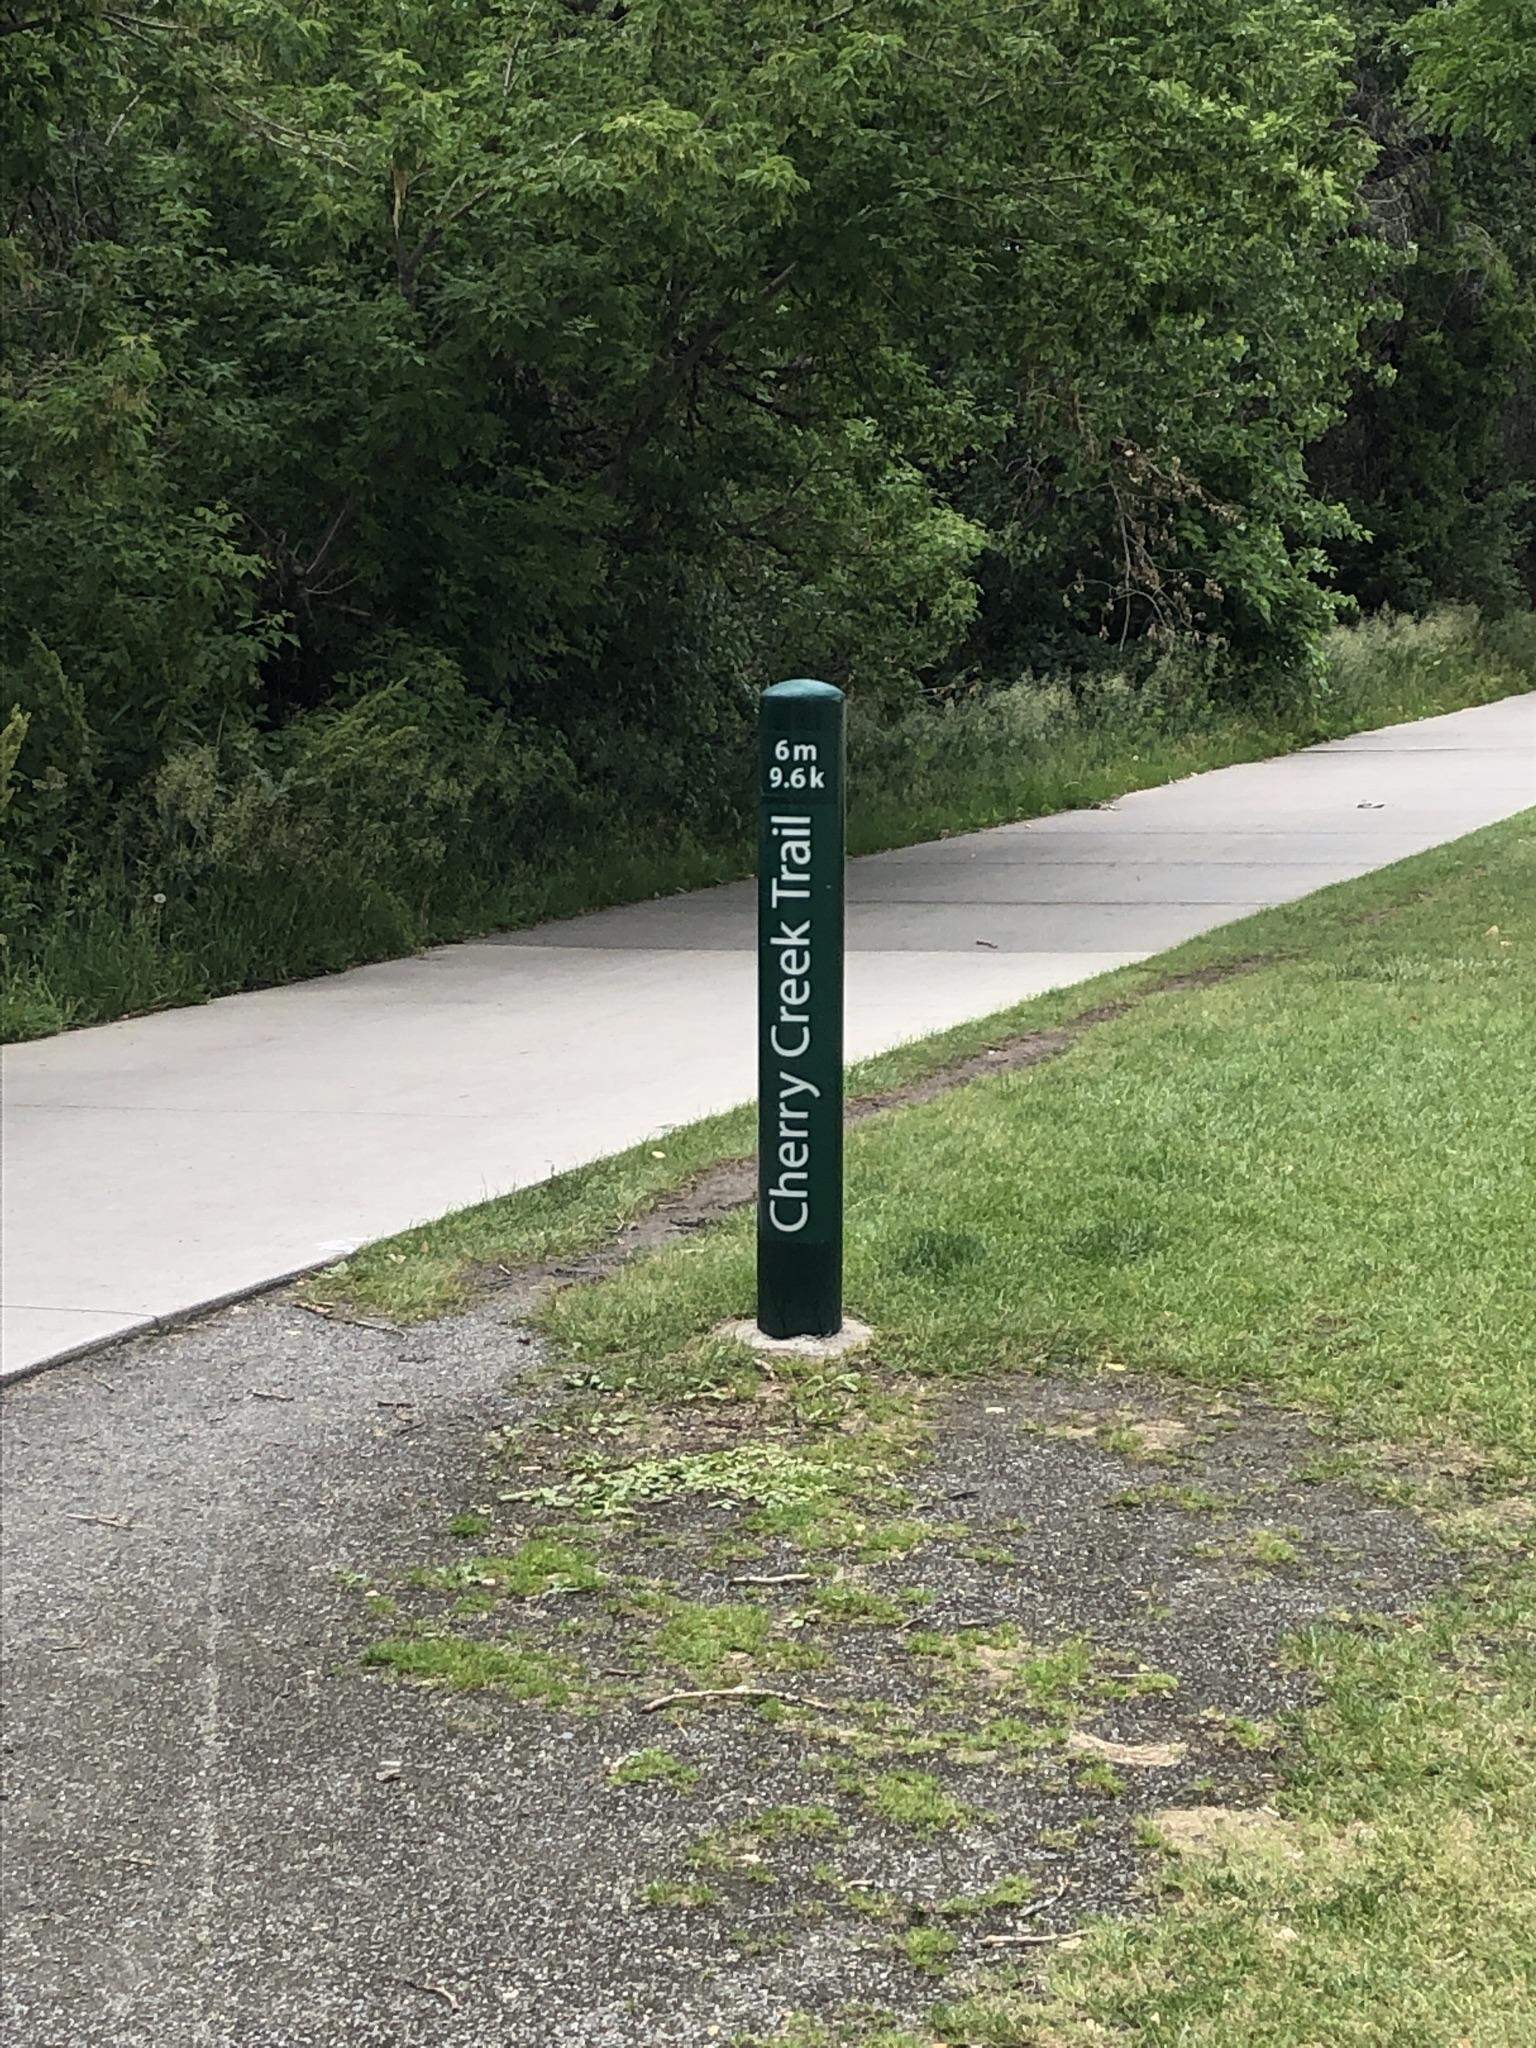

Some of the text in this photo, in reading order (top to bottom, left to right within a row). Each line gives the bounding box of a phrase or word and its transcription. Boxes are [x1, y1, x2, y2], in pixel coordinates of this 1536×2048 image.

[774, 739, 818, 761] 6m
[769, 766, 825, 789] 9.6k
[768, 815, 820, 1232] Cherry Creek Trail
